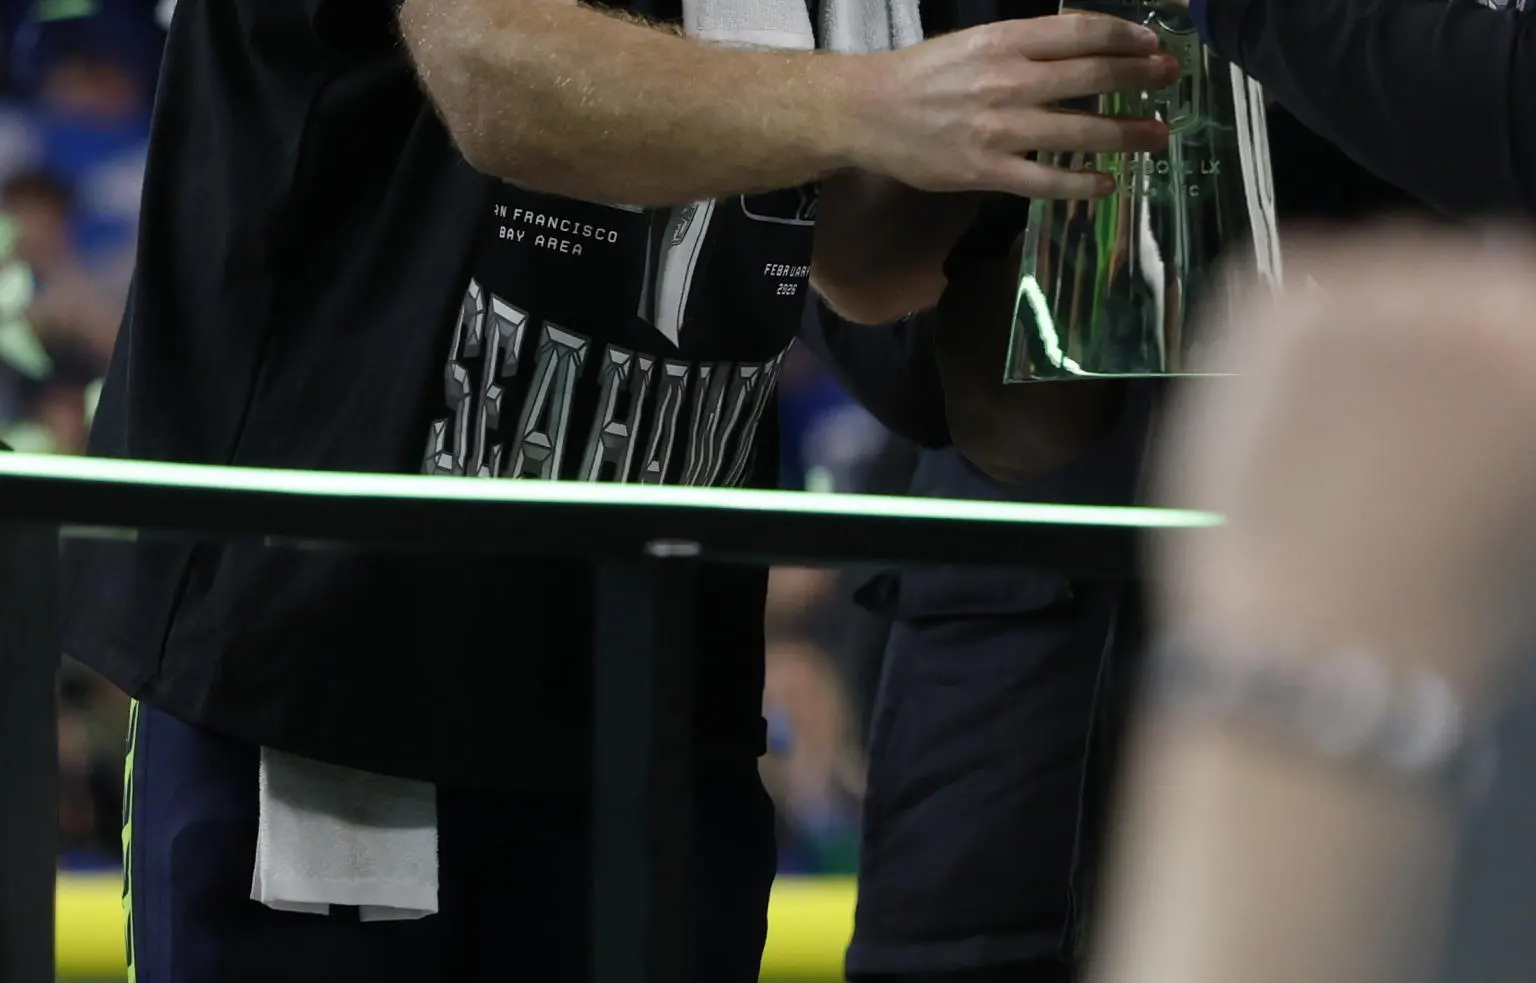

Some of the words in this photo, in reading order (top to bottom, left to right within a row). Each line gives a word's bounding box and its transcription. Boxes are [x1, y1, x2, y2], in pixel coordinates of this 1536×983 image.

[498, 225, 526, 243] BAY
[534, 234, 583, 256] AREA
[513, 207, 618, 244] FRANCISCO
[776, 282, 798, 297] 2026
